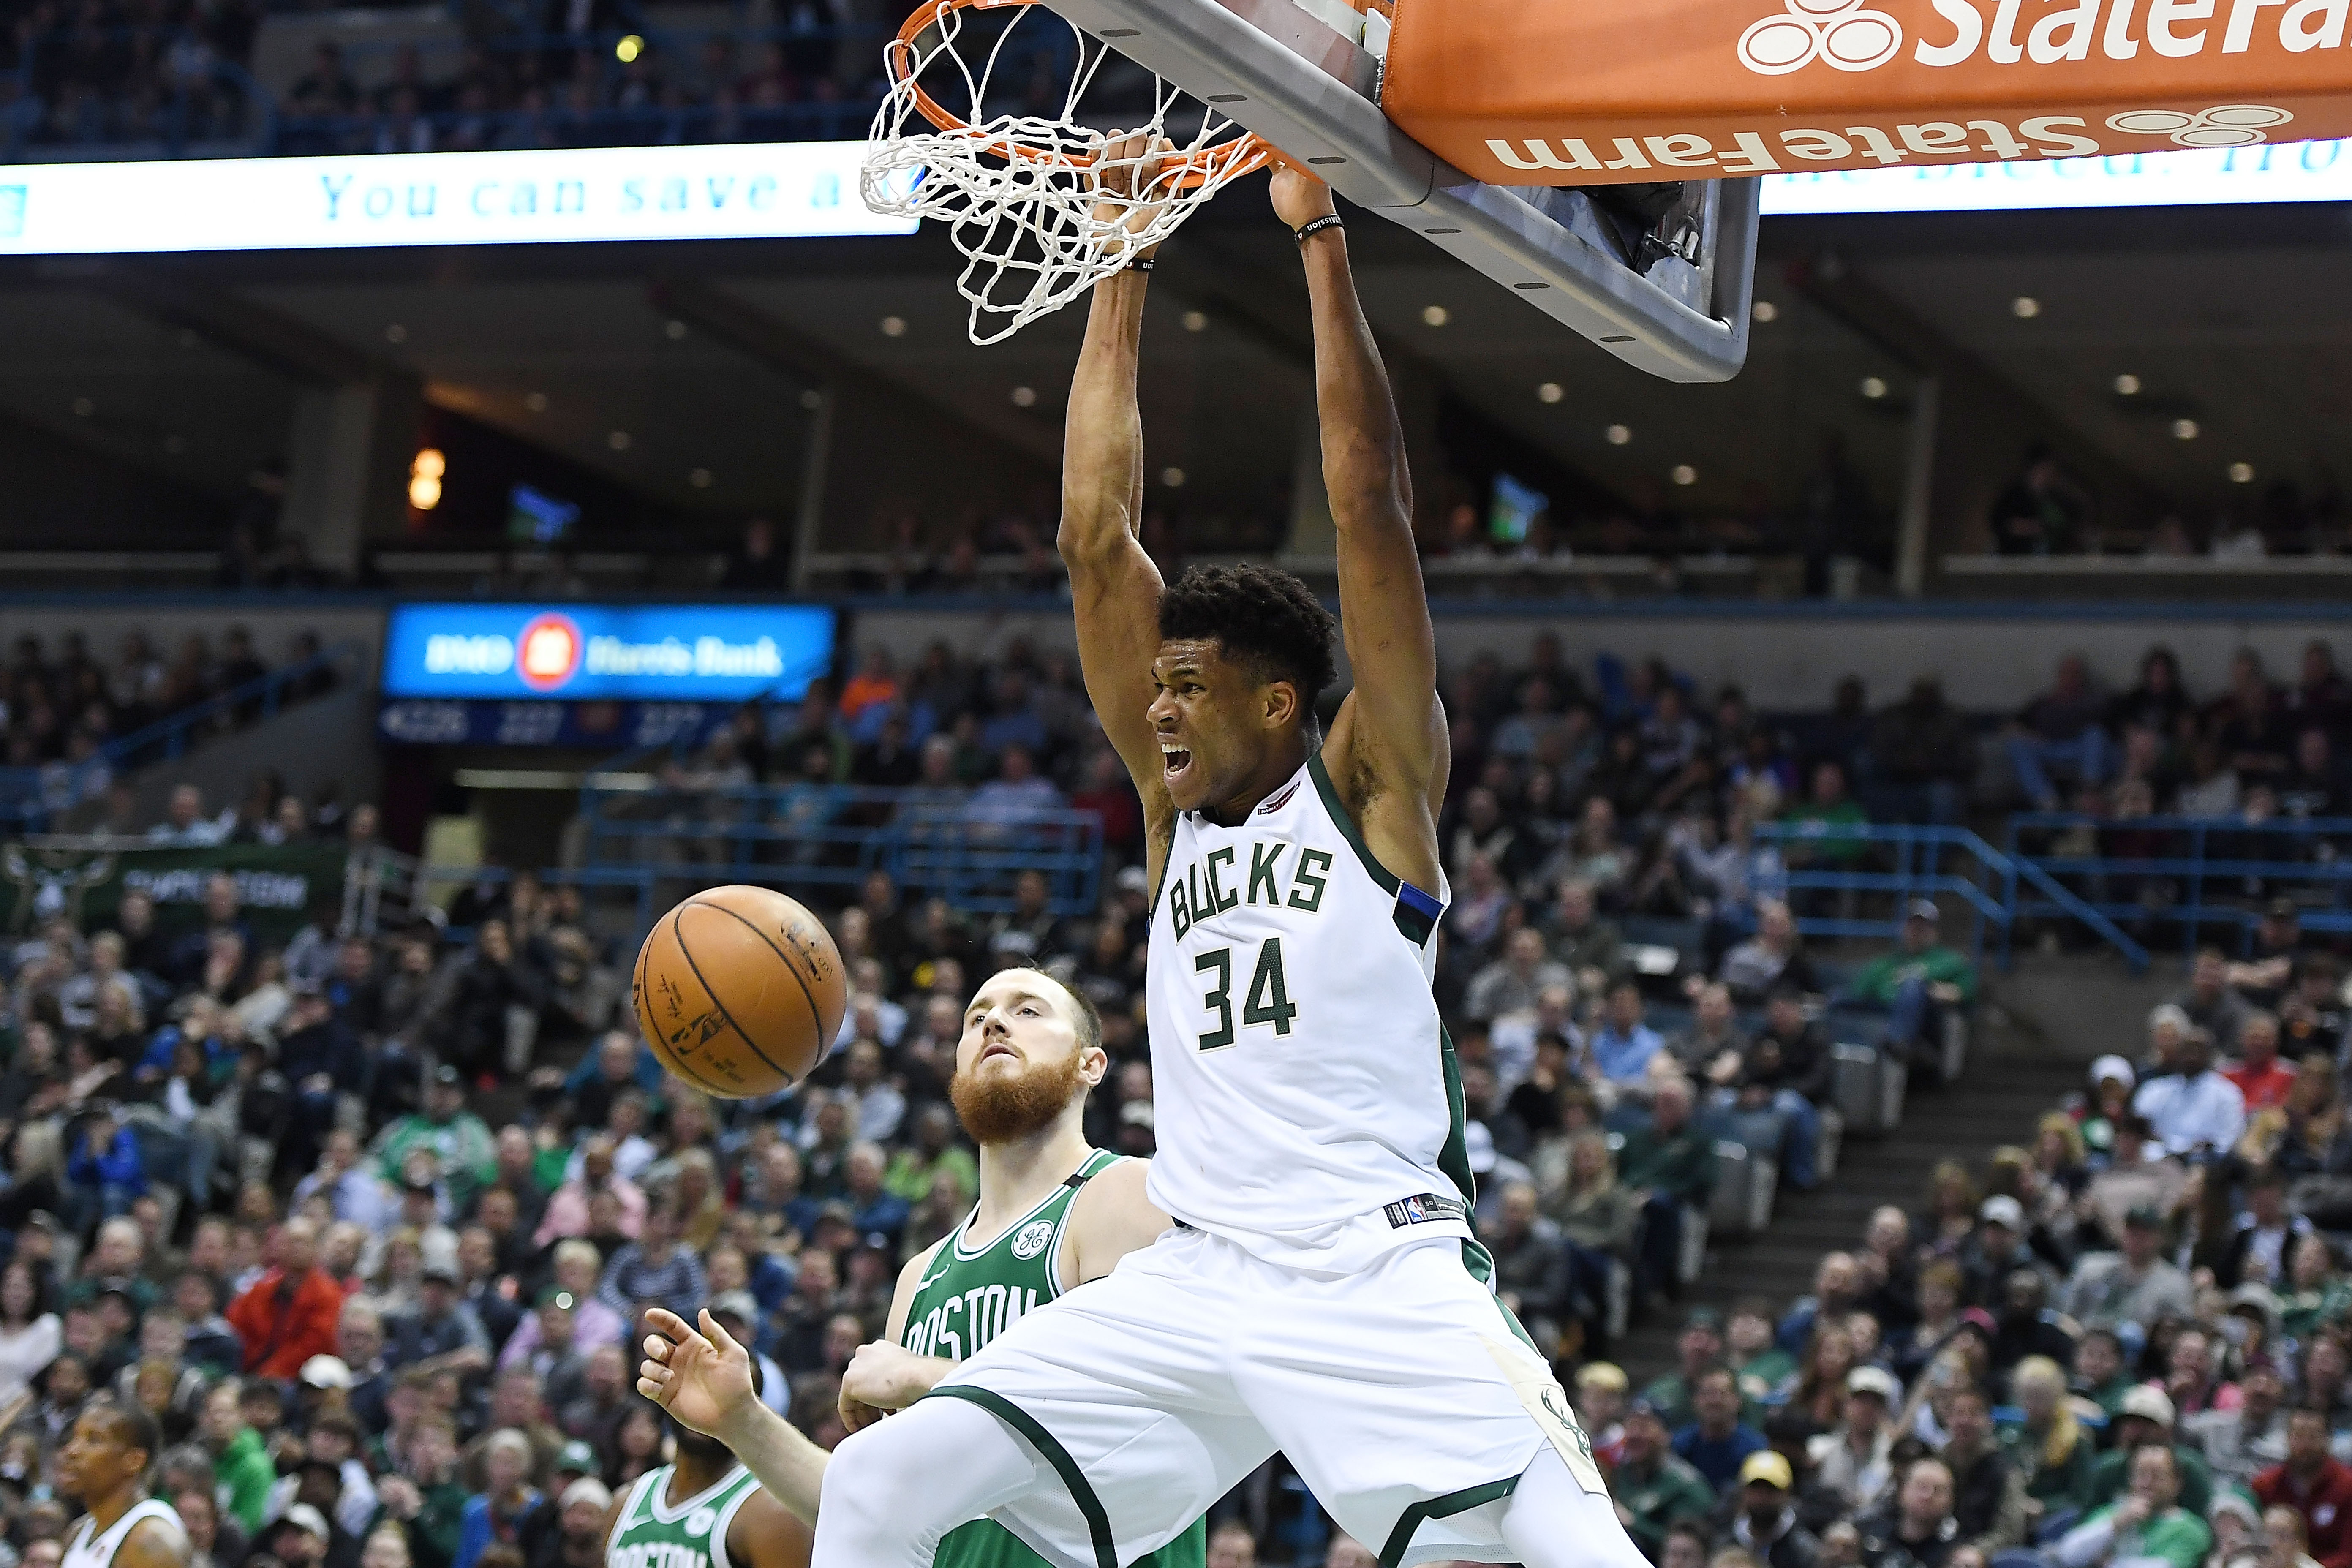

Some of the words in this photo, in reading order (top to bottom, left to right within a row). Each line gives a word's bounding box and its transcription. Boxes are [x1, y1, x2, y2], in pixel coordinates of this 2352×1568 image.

[320, 172, 438, 220] You
[469, 178, 586, 216] can
[618, 172, 777, 213] save
[808, 169, 841, 210] a
[1307, 216, 1339, 231] Mission
[1169, 842, 1335, 945] BUCKS
[1193, 936, 1300, 1054] 34
